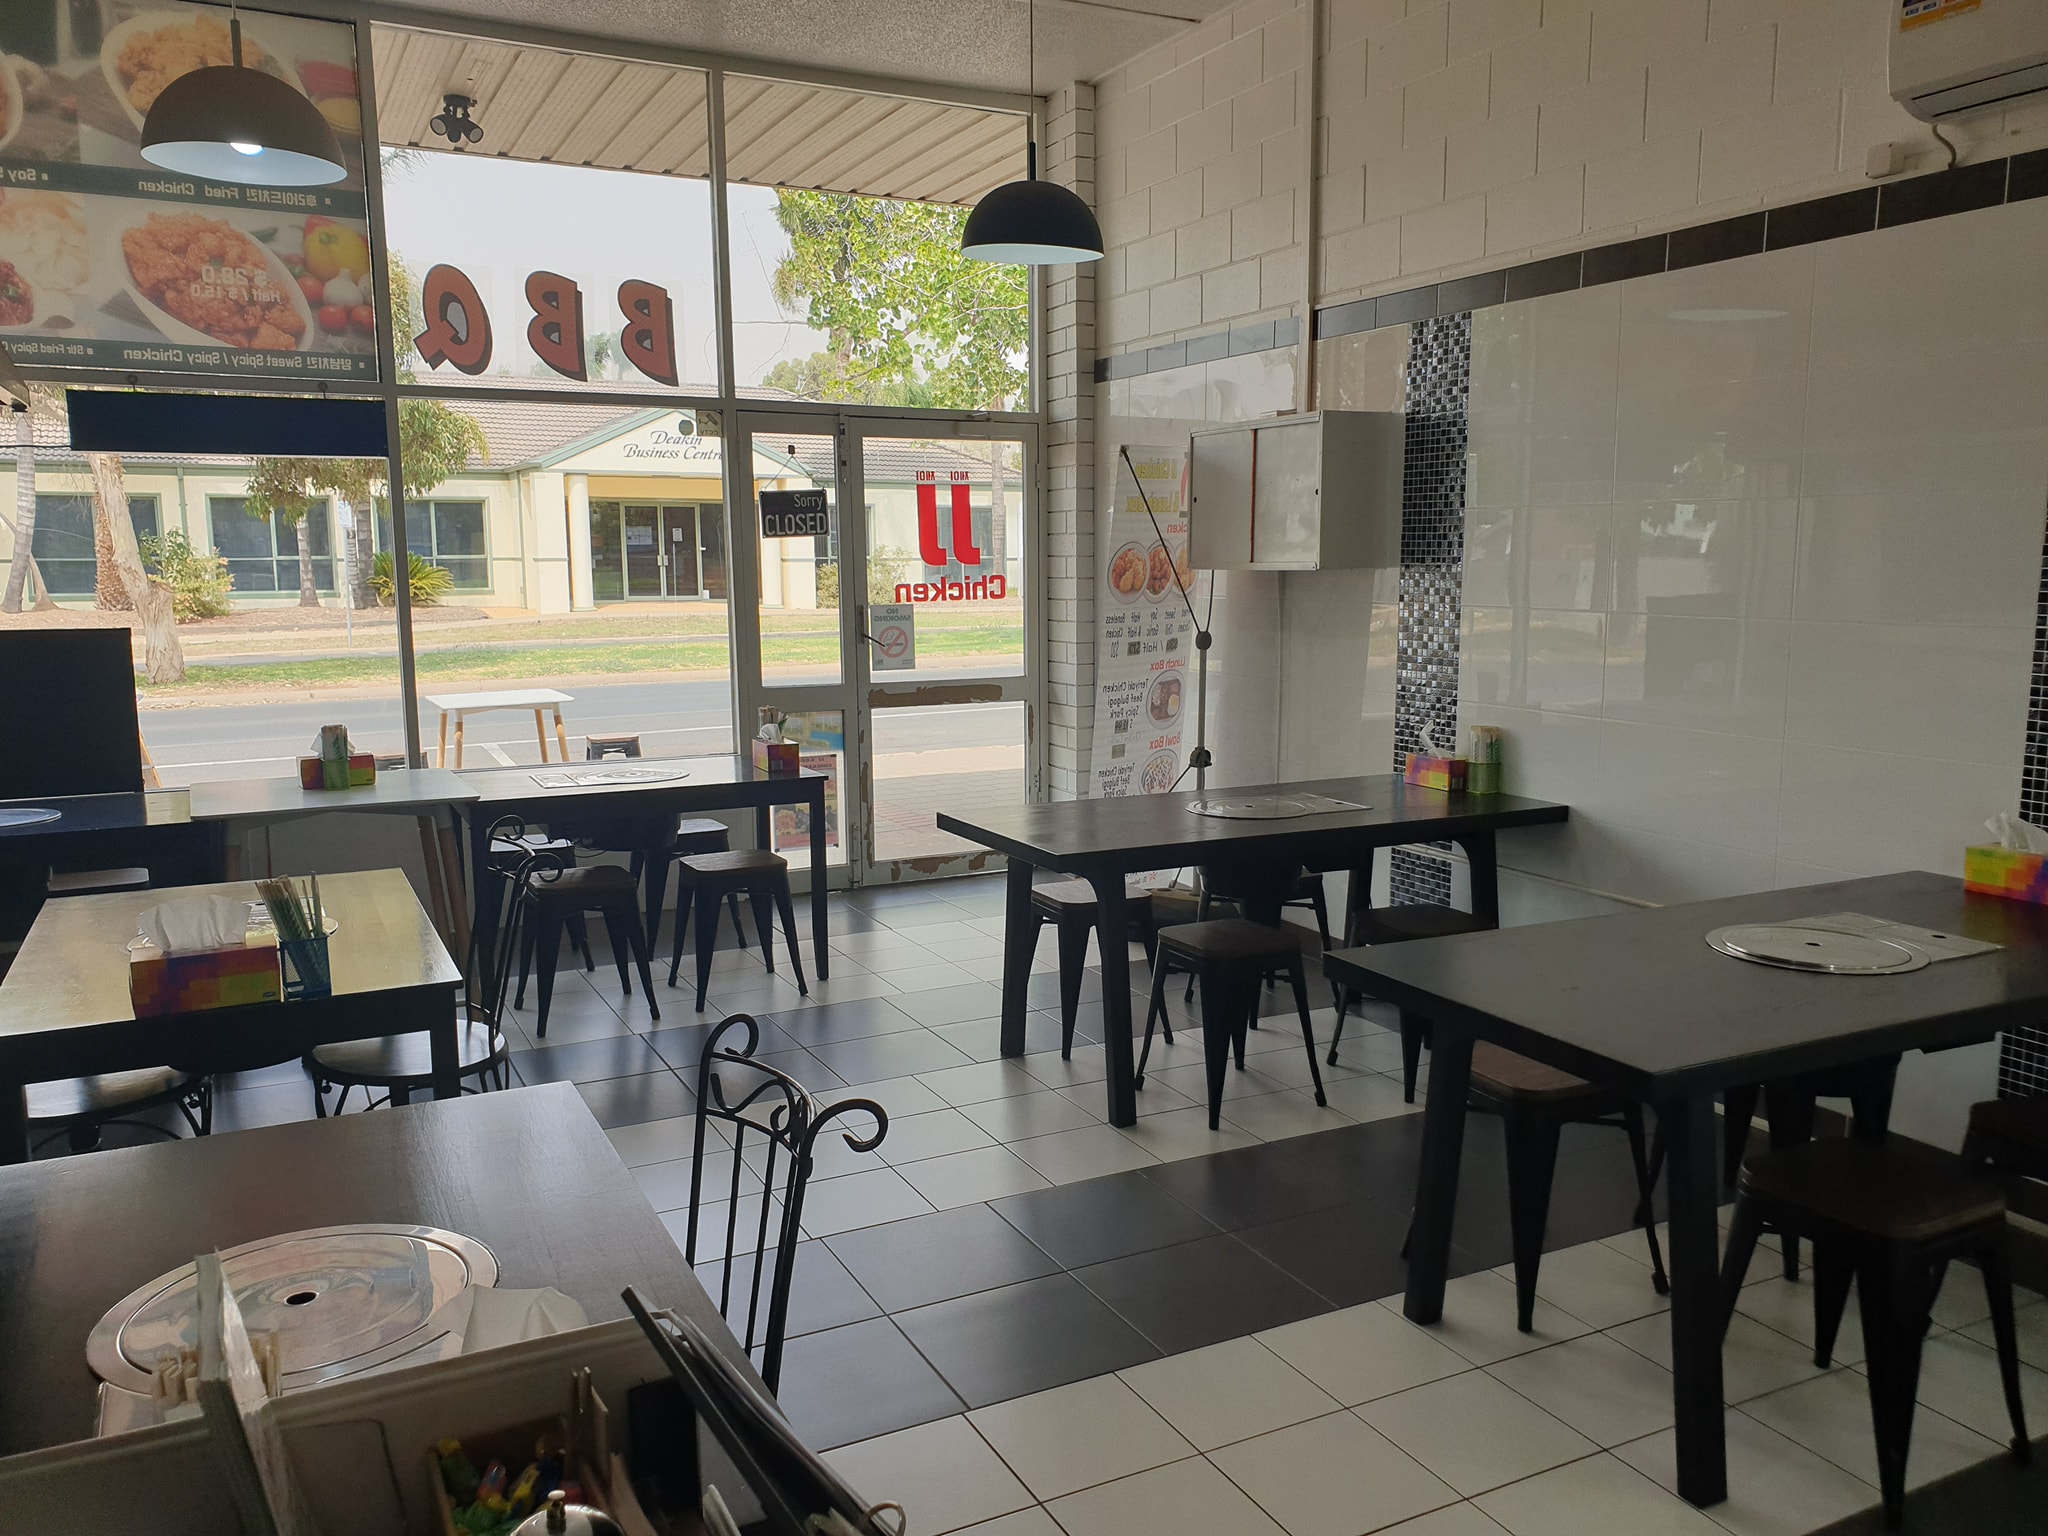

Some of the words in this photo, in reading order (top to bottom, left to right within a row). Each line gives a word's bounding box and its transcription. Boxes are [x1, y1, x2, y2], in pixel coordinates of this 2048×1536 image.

[650, 430, 702, 445] Deakin
[623, 443, 680, 460] Business
[794, 493, 823, 510] Sorry
[765, 512, 827, 536] CLOSED
